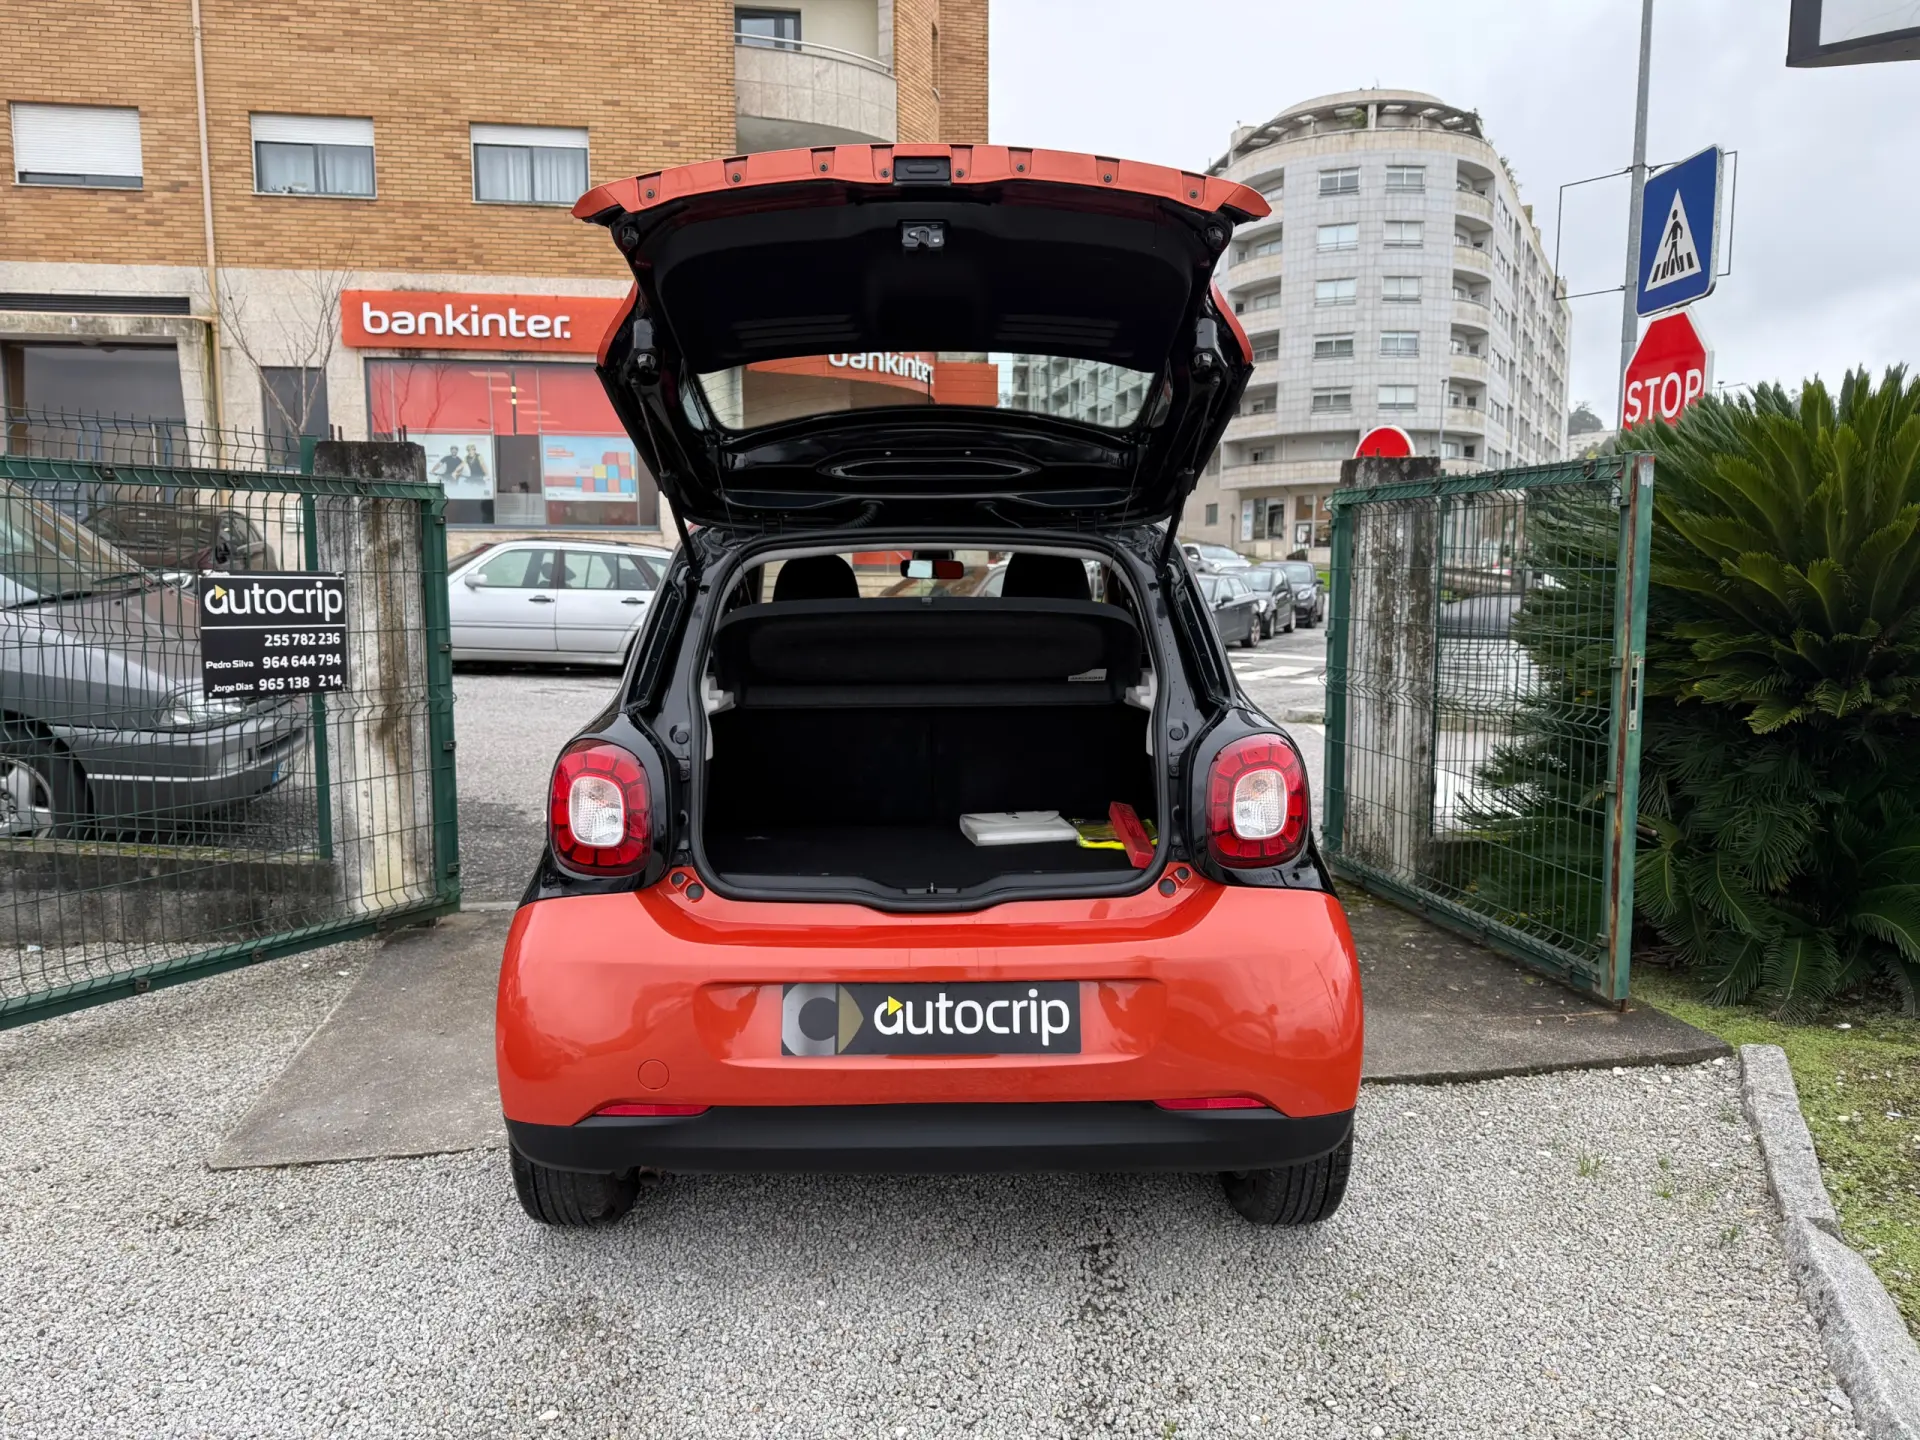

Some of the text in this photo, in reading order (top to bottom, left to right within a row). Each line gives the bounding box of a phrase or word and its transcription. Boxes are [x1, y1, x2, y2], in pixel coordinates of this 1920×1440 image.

[362, 301, 572, 339] bankinter.
[1625, 368, 1702, 423] STOP
[204, 581, 343, 622] autocrip
[264, 632, 341, 647] 255 782 236
[205, 653, 342, 669] Pedro Silva 964 644 794
[211, 683, 235, 693] Jorge
[235, 682, 254, 691] Dias
[258, 678, 285, 691] 965
[287, 676, 310, 690] 138
[873, 988, 1071, 1046] autocrip
